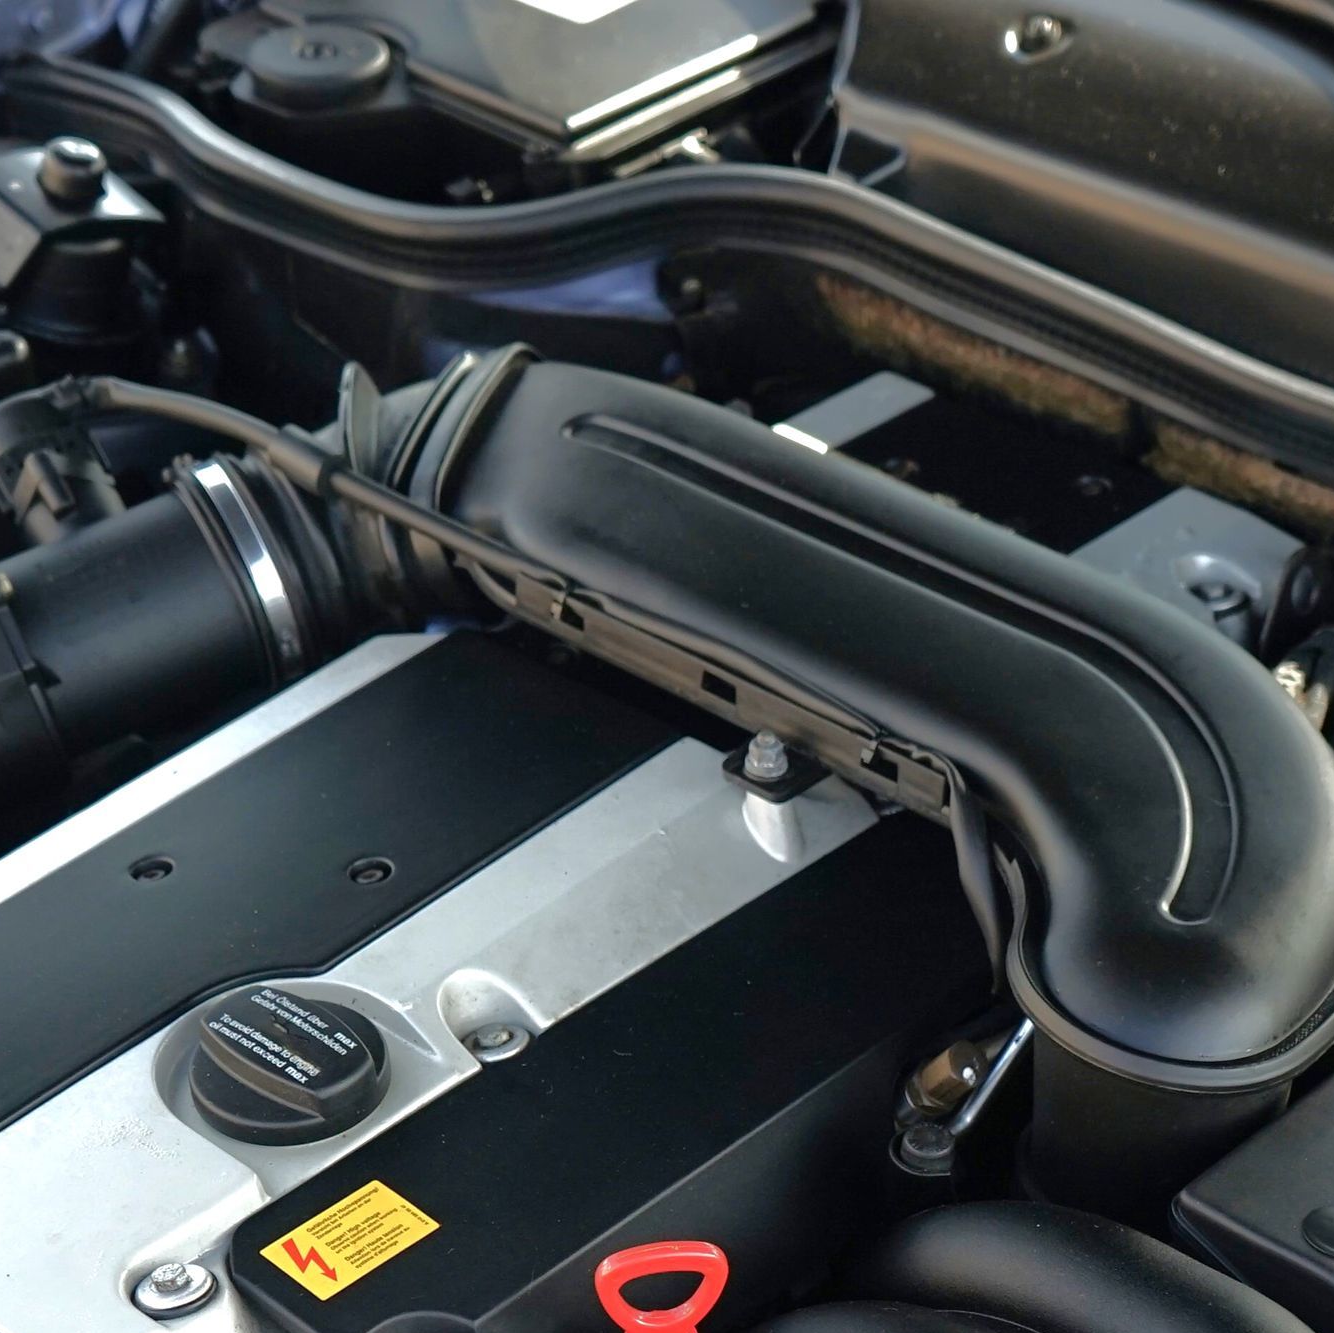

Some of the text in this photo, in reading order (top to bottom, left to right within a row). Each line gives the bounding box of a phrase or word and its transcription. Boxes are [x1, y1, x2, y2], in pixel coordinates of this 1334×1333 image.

[219, 1013, 322, 1077] To avoid damage to engine
[251, 994, 348, 1056] Gefahr von Motorschäden
[261, 988, 358, 1049] Bei Ölstand über max
[209, 1021, 309, 1084] oil must not exceed max
